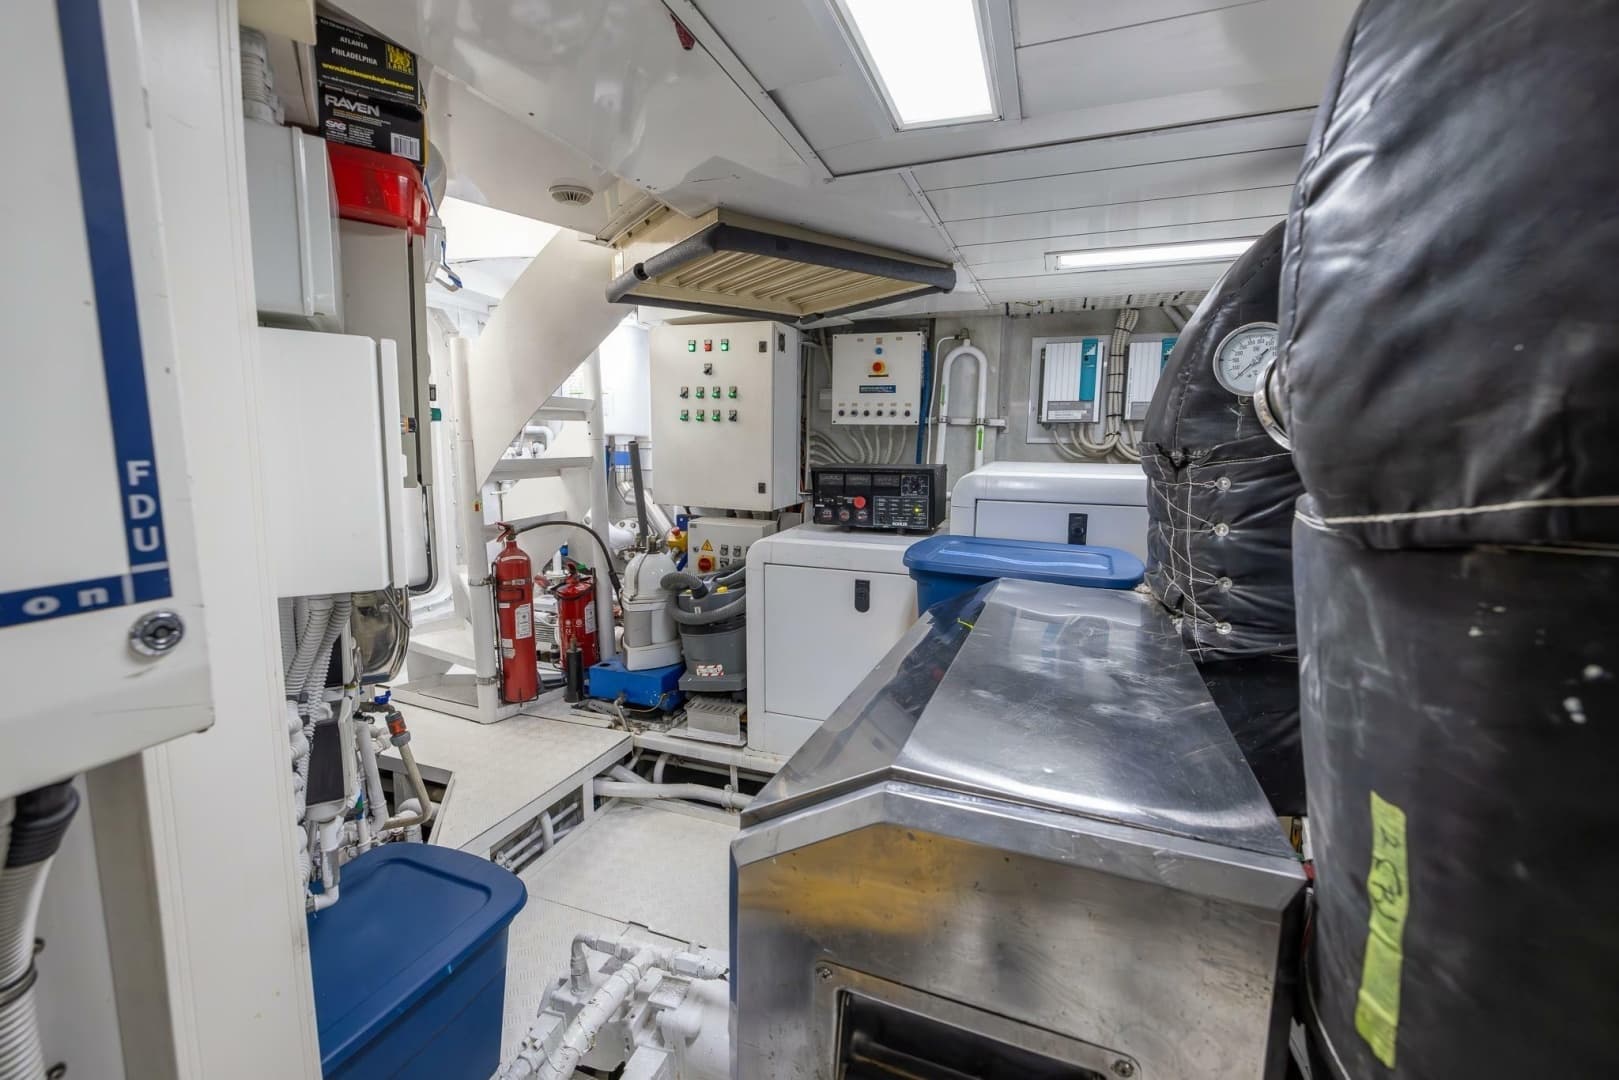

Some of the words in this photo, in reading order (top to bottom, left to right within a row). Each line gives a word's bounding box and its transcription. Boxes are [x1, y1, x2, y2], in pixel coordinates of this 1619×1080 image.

[340, 36, 368, 49] ATLANTA
[331, 47, 378, 66] PHILADELPHIA
[324, 94, 380, 117] RAVEN
[126, 460, 160, 552] FDU
